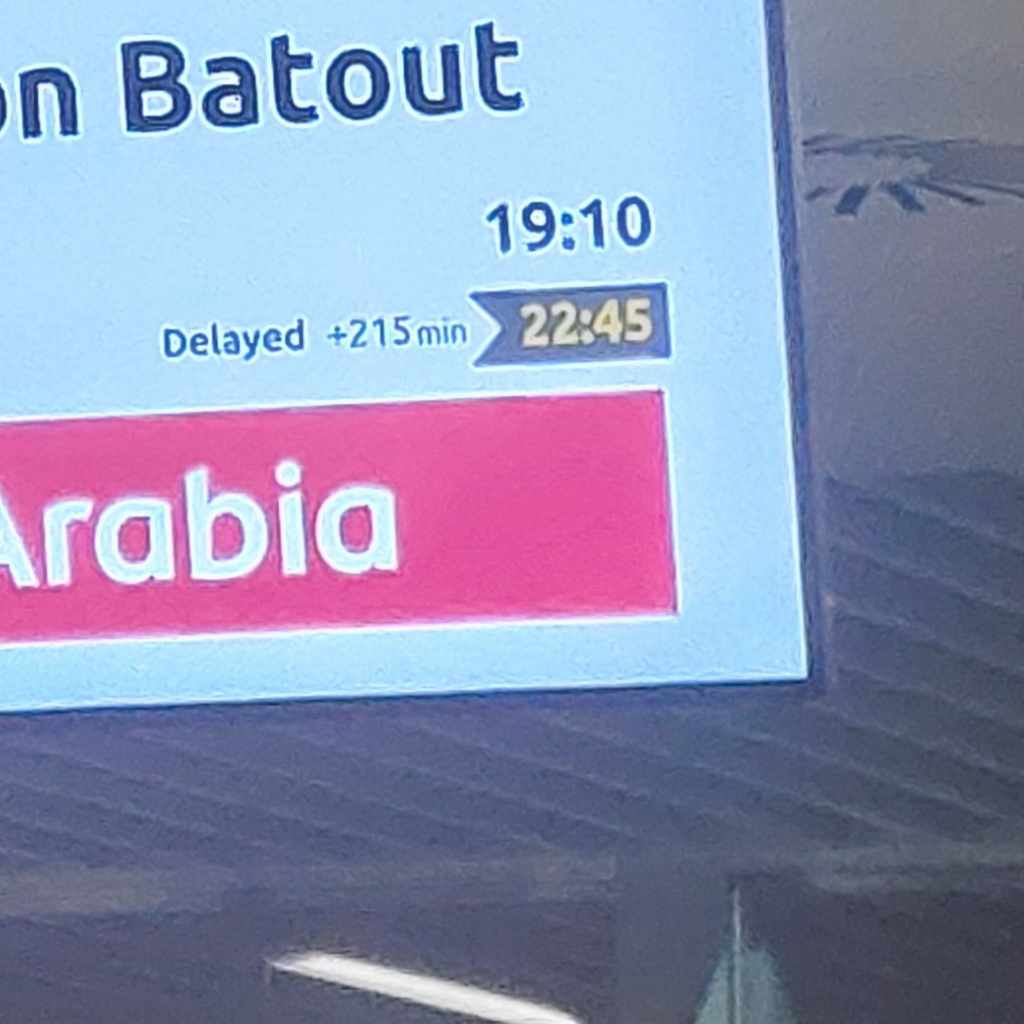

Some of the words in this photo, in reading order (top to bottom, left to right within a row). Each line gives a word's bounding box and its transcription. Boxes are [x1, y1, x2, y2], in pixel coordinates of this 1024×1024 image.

[120, 21, 522, 134] Batout
[486, 195, 653, 254] 19:10
[164, 318, 304, 360] Delayed
[519, 296, 653, 350] 22:45
